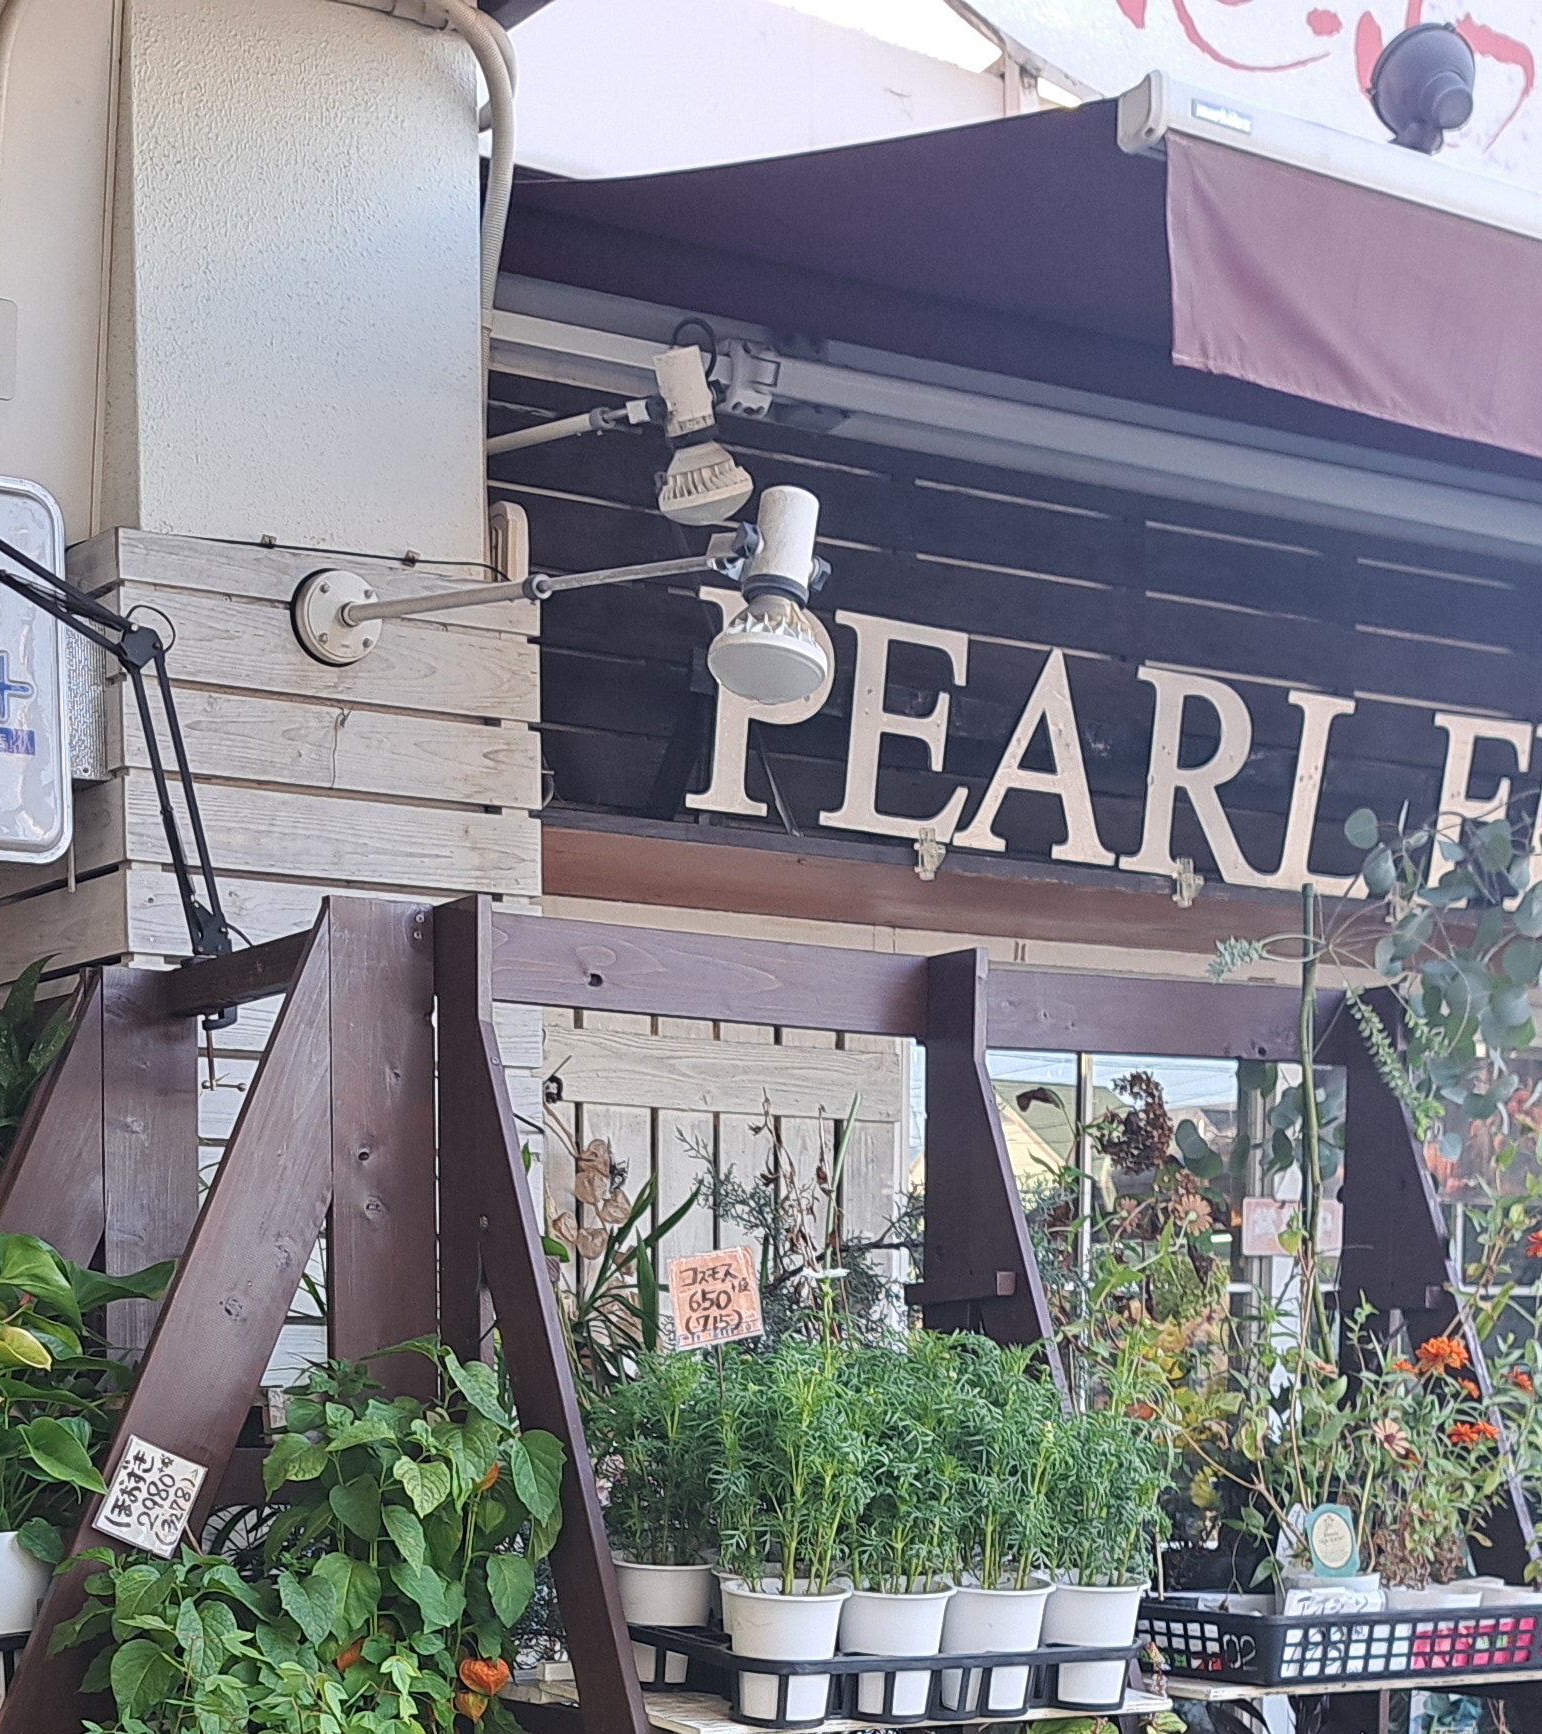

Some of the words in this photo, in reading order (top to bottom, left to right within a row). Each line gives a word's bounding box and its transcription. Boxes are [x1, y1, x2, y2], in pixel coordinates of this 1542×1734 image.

[685, 586, 1369, 899] PEARL
[679, 1263, 739, 1288] コスモス
[688, 1288, 733, 1314] 650
[137, 1473, 176, 1532] 2980
[1222, 1633, 1258, 1672] 02
